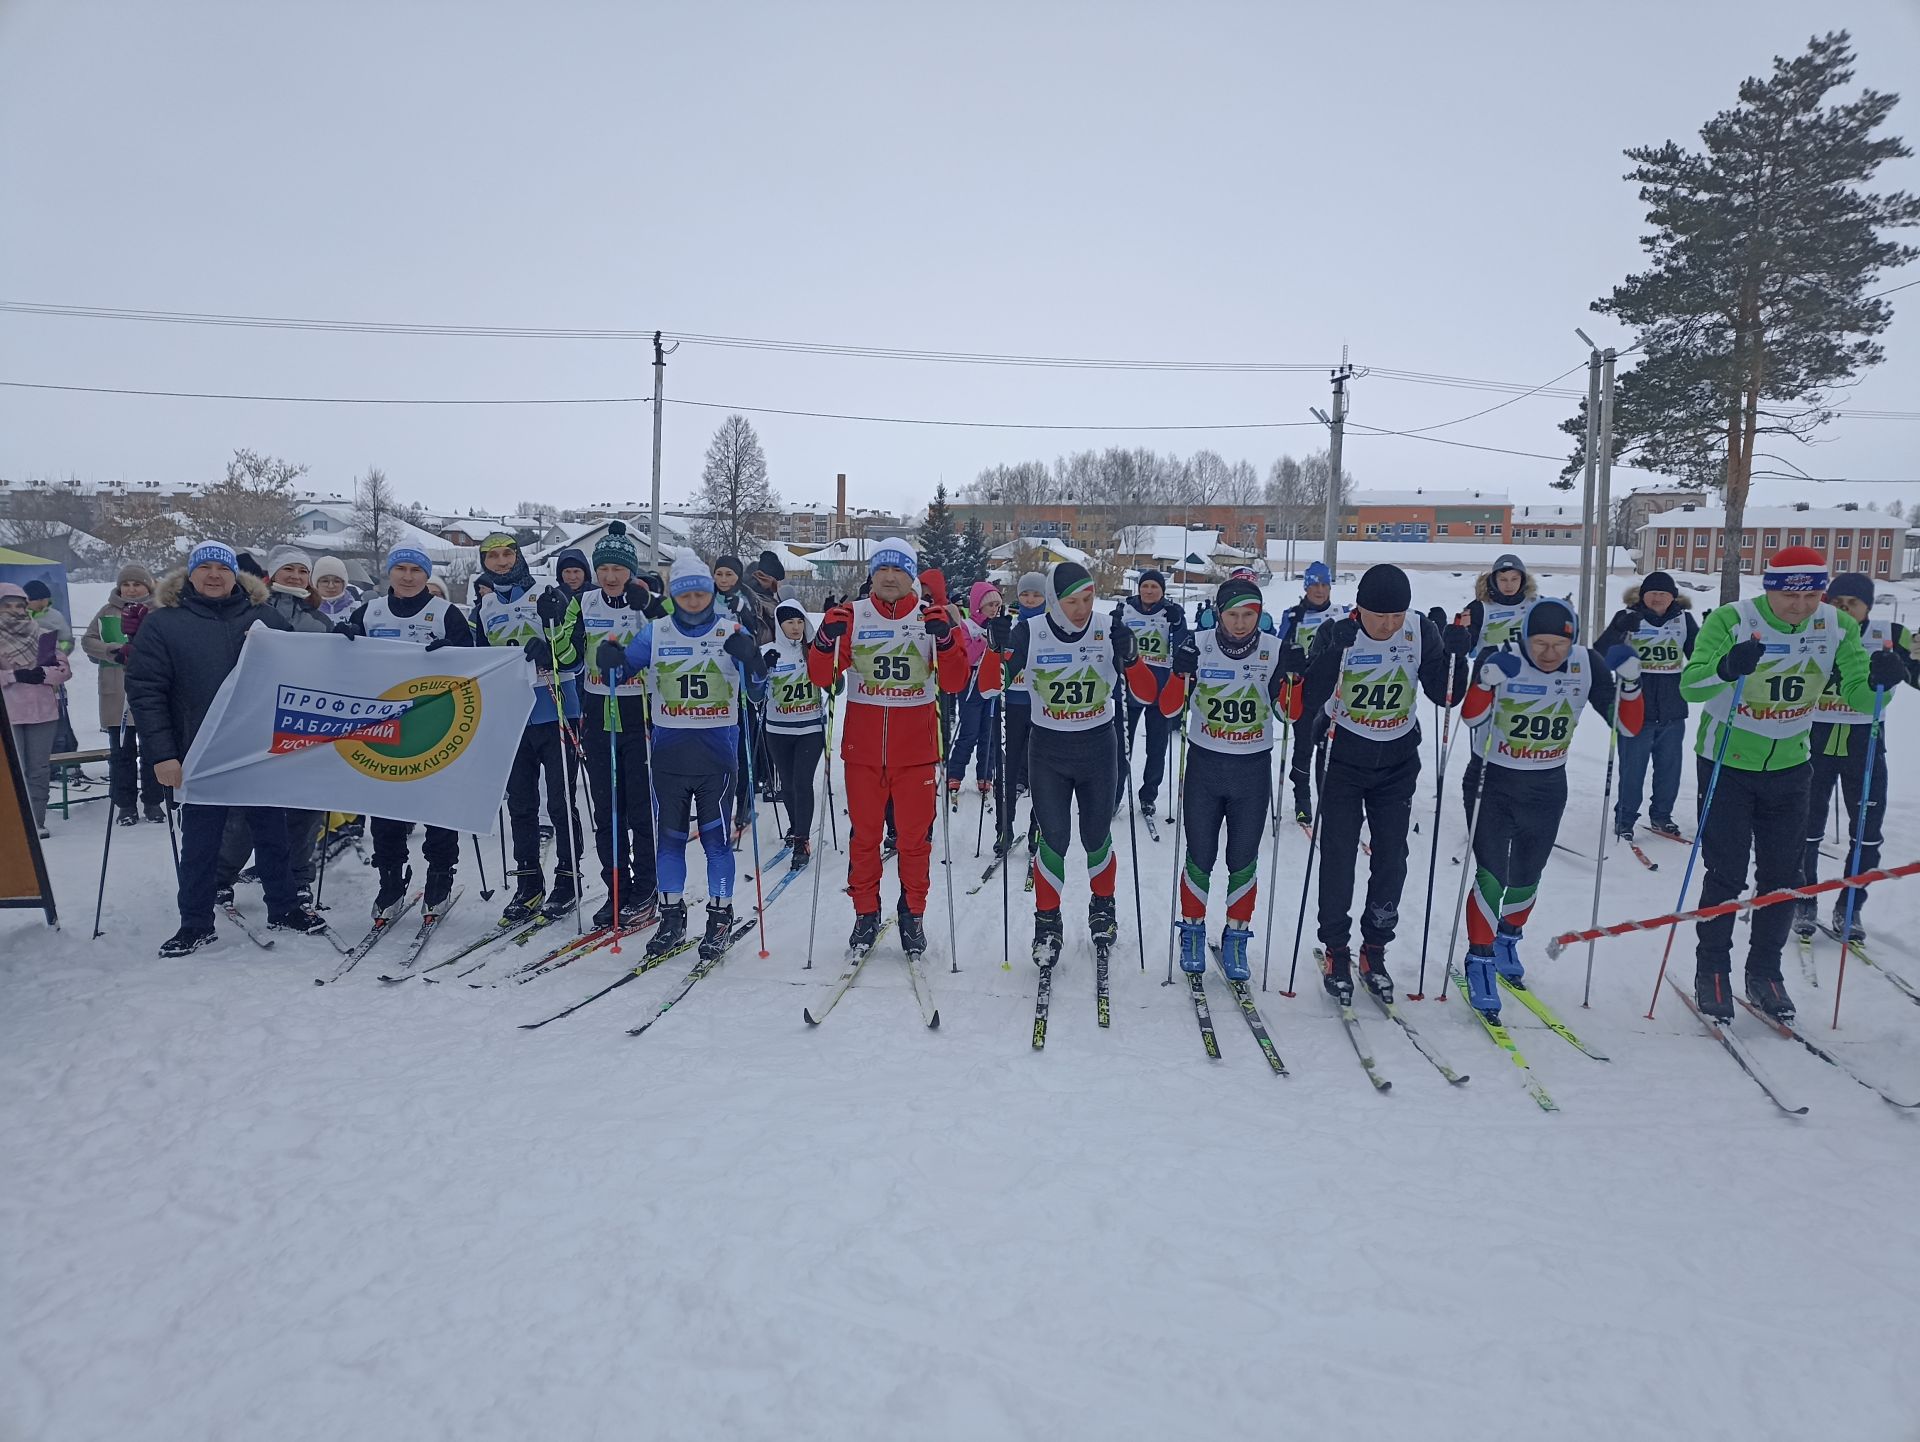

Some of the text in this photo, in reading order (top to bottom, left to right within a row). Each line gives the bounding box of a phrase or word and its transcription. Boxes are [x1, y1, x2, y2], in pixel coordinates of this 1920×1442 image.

[1138, 637, 1161, 653] 92
[1638, 646, 1679, 661] 296
[873, 656, 911, 680] 35
[676, 674, 709, 699] 15
[782, 682, 813, 703] 241
[858, 683, 925, 697] Kukmara
[1049, 681, 1096, 705] 237
[1351, 683, 1404, 710] 242
[1765, 675, 1806, 702] 16
[283, 692, 408, 716] ПРОФСОЮЗ
[660, 703, 729, 717] Kukmara
[1042, 706, 1105, 720] Kukmara
[1207, 698, 1257, 724] 299
[1737, 703, 1812, 720] Kukmar
[1201, 722, 1263, 741] Kukmara
[1509, 714, 1569, 740] 298
[351, 734, 464, 776] ОБСЛУЖИВАНИЯ
[647, 941, 699, 970] FISCHER
